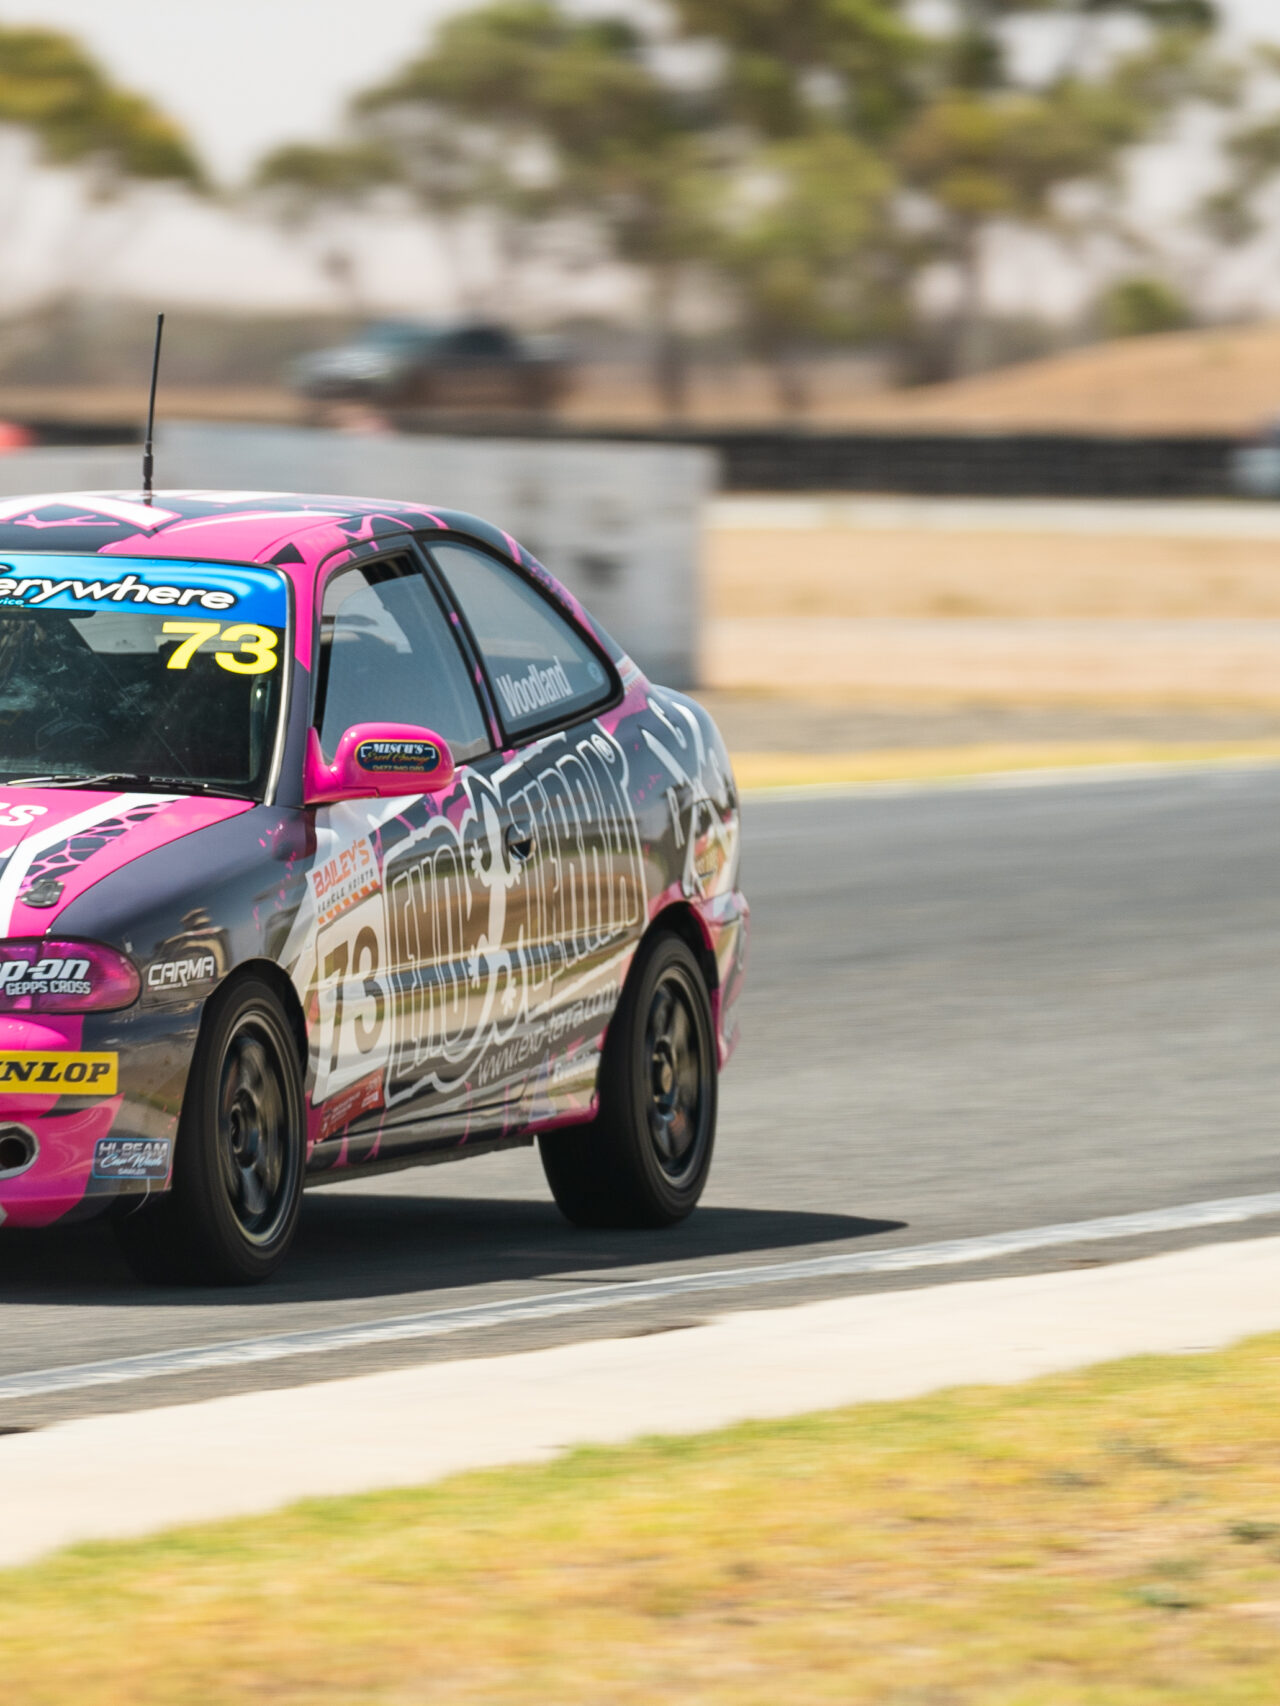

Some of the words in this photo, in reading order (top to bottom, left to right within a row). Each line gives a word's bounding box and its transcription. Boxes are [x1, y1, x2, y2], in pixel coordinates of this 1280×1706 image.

[160, 621, 278, 675] 73
[496, 655, 573, 718] Woodland
[313, 838, 370, 899] BAILEY'S
[6, 981, 48, 996] GEPPS
[49, 981, 91, 994] CROSS
[148, 956, 215, 987] CARMA
[324, 925, 386, 1075] 73
